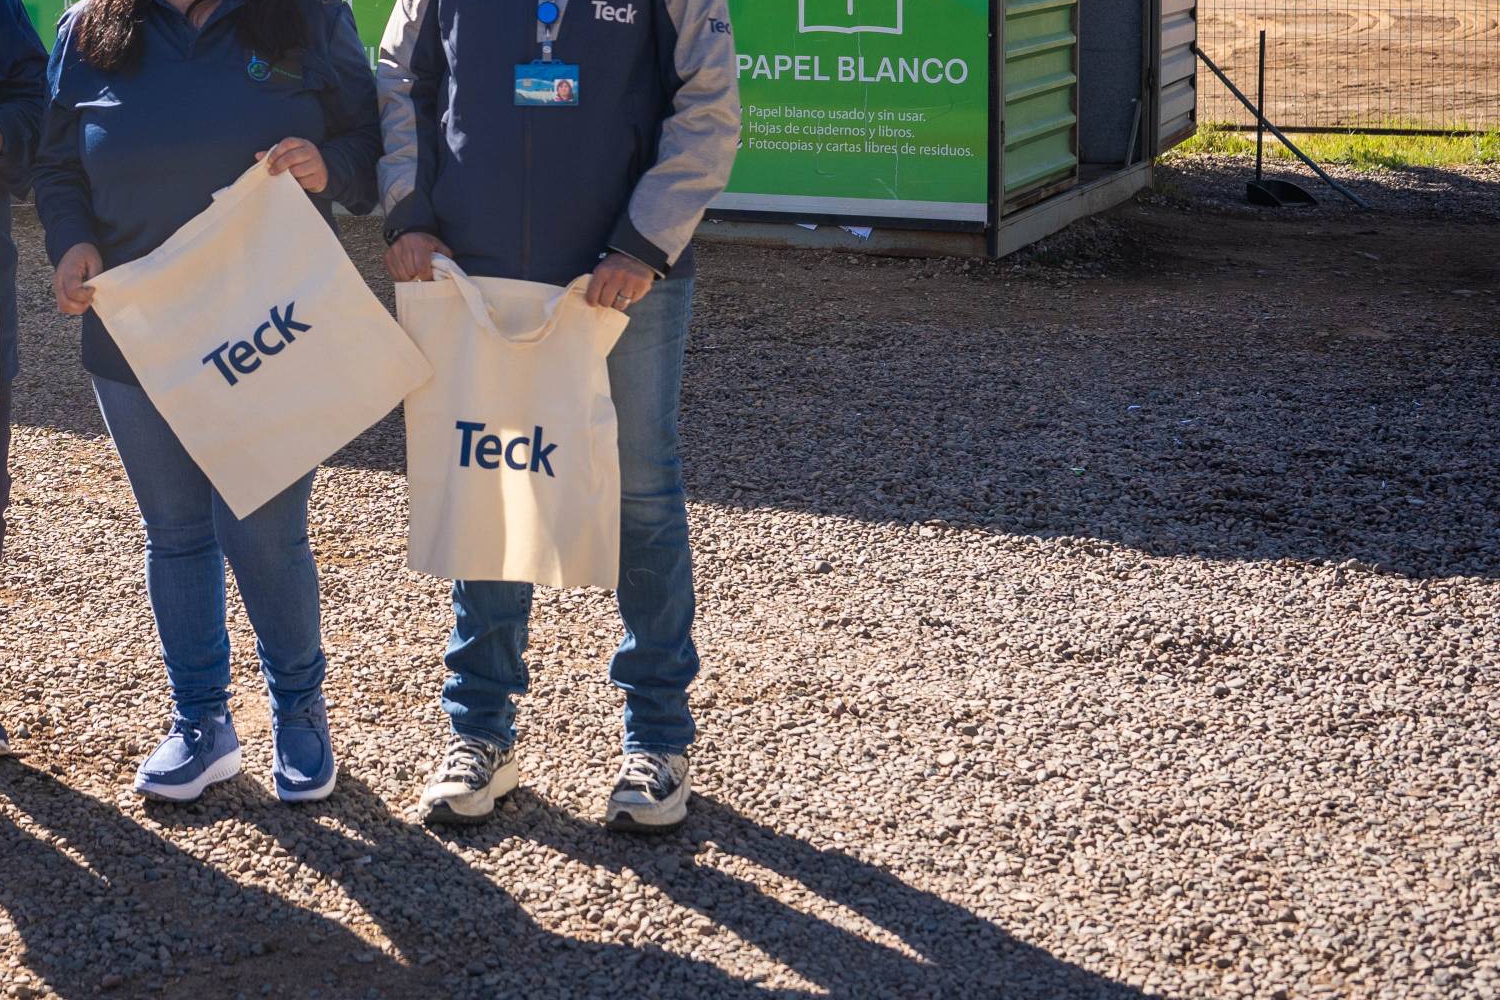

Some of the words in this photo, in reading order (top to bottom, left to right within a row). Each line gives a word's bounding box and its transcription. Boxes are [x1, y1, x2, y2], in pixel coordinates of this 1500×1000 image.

[591, 0, 638, 24] Teck
[708, 18, 731, 35] Tec
[735, 55, 831, 81] PAPEL
[838, 56, 969, 85] BLANCO
[749, 105, 781, 119] Papel
[784, 106, 825, 119] blanco
[828, 108, 865, 120] usado
[868, 112, 875, 123] y
[877, 110, 894, 121] sin
[898, 112, 927, 122] usar.
[749, 121, 781, 136] Hojas
[784, 122, 800, 134] de
[802, 124, 866, 137] cuadernos
[869, 127, 876, 139] y
[878, 125, 916, 138] libros.
[749, 138, 813, 152] Fotocopias
[816, 142, 824, 154] y
[825, 142, 861, 153] cartas
[865, 141, 898, 154] libres
[901, 143, 916, 155] de
[920, 144, 974, 157] residuos.
[202, 301, 312, 387] Teck
[456, 420, 558, 478] Teck
